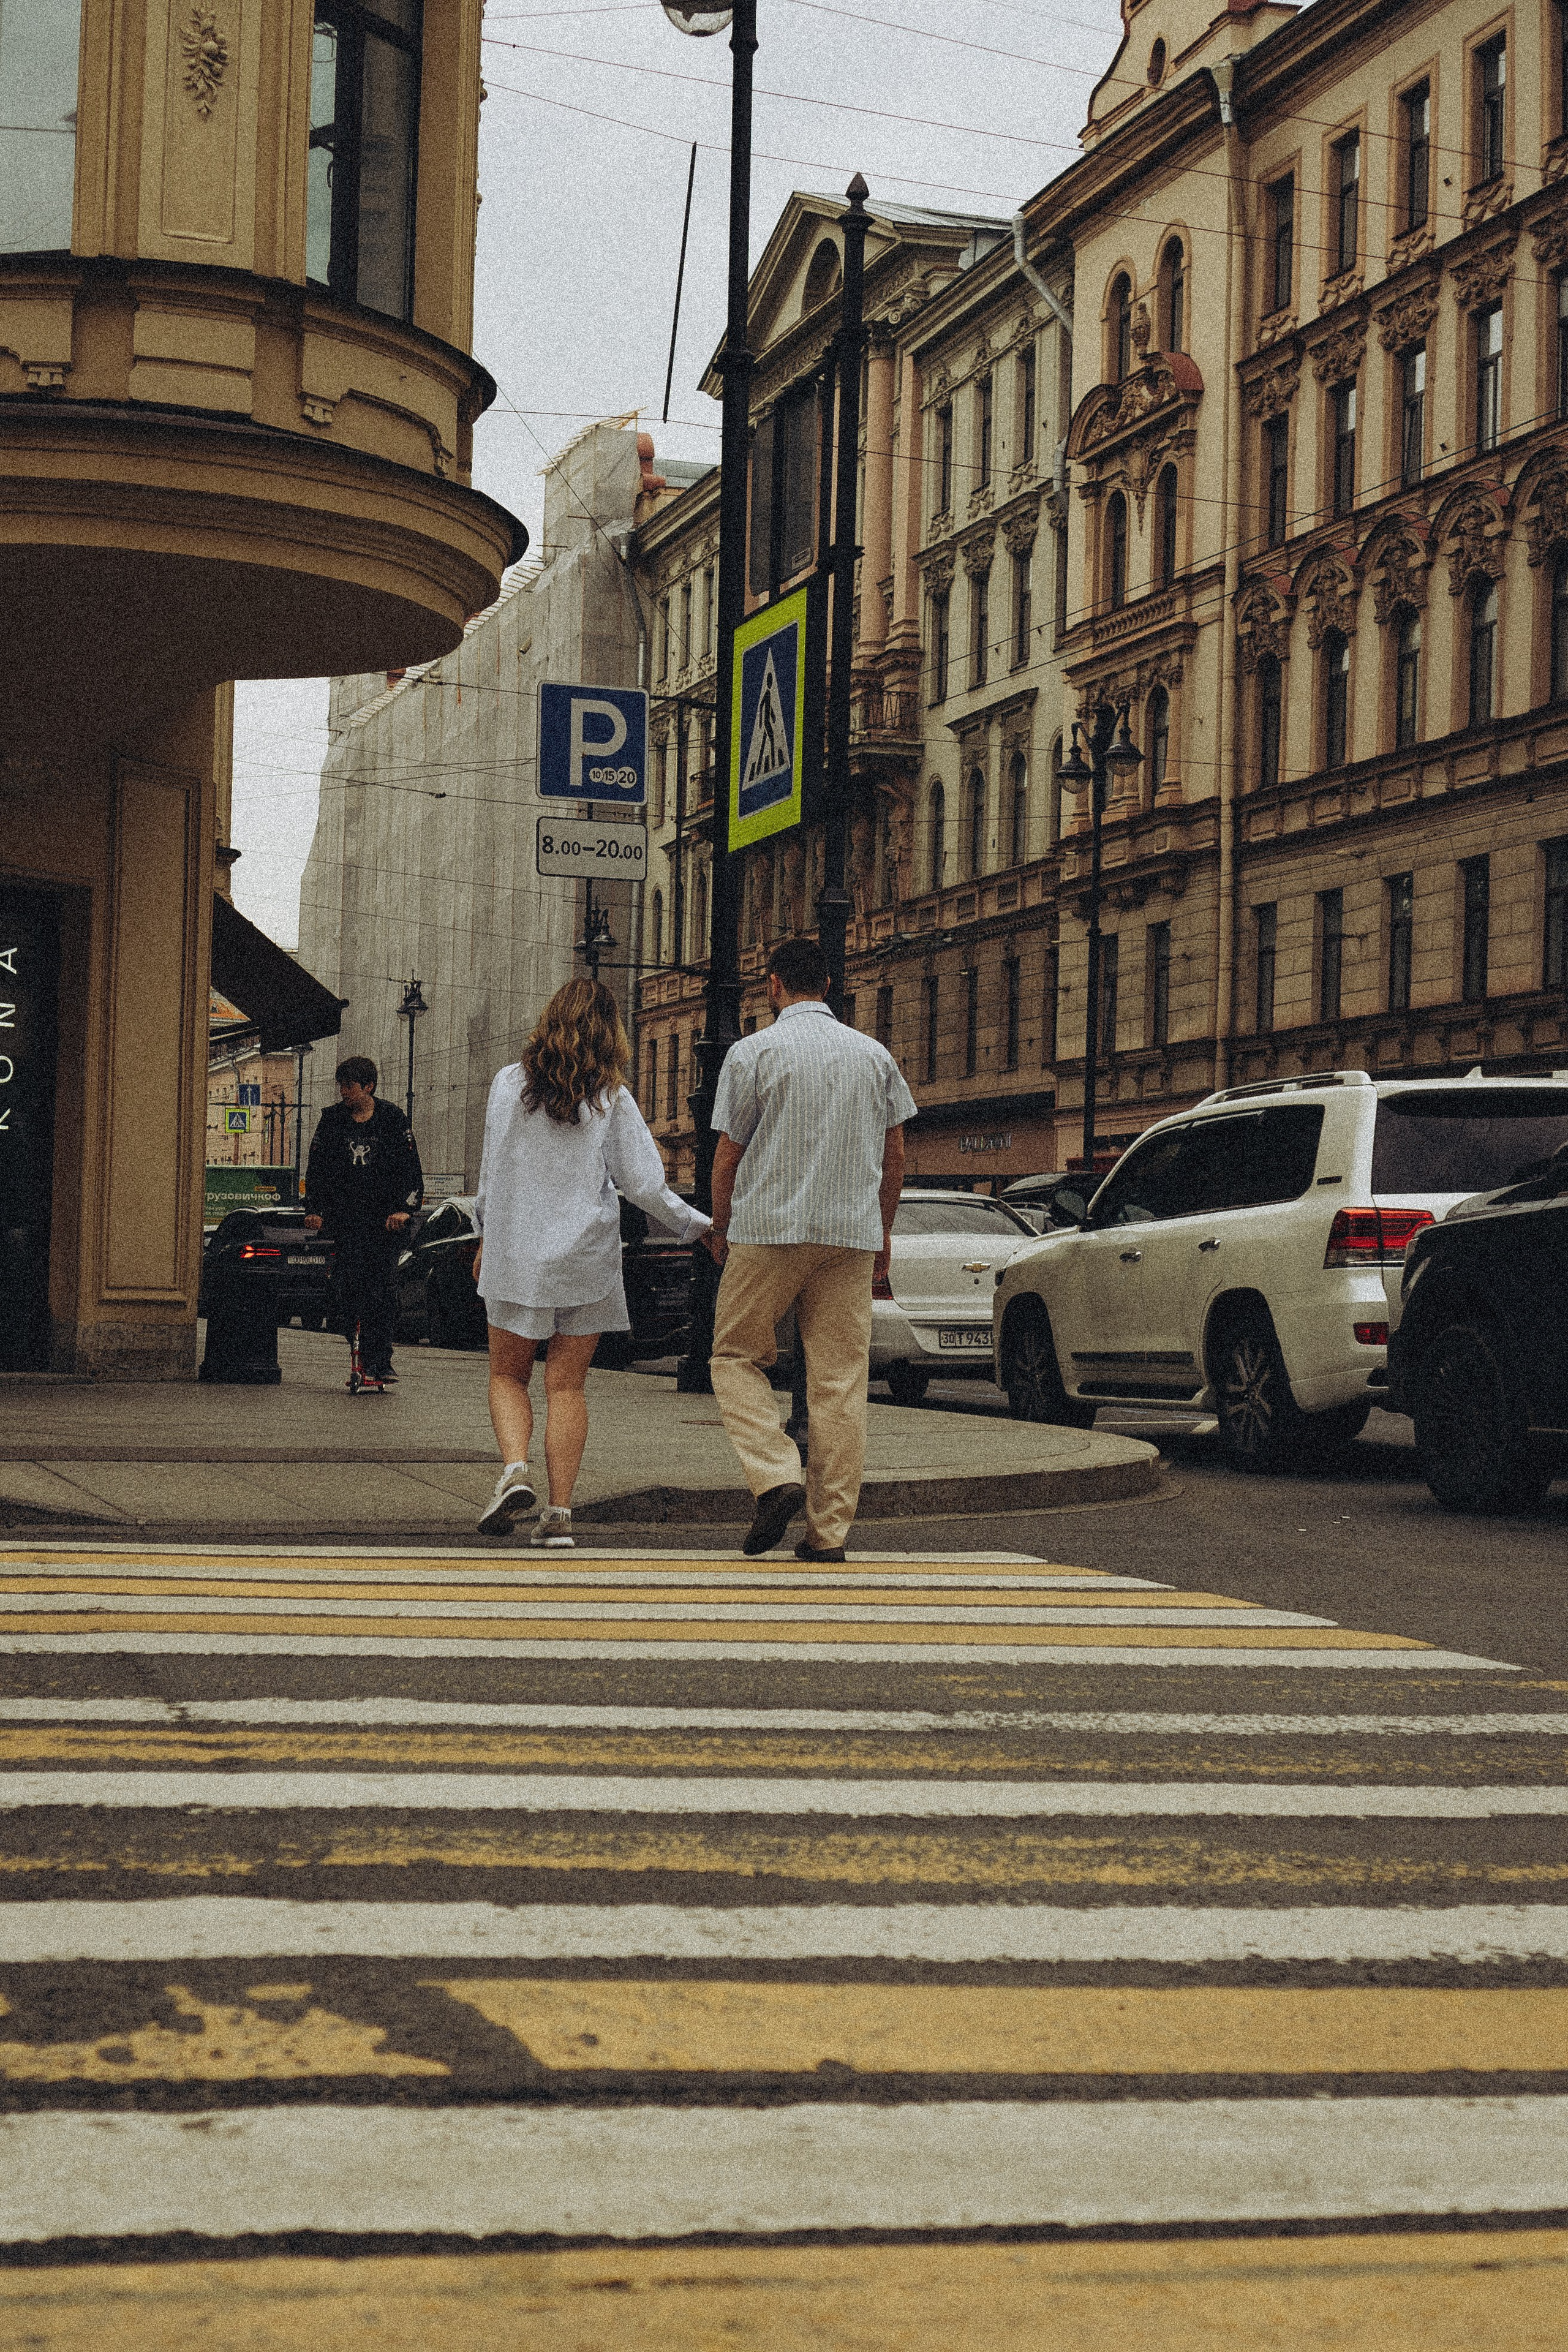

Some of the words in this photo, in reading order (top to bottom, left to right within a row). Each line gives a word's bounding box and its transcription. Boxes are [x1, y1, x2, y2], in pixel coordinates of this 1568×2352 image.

[570, 698, 627, 786] P
[592, 771, 601, 779] 10
[604, 772, 615, 782] 15
[619, 771, 635, 784] 20
[205, 1192, 281, 1202] рузовичкоф
